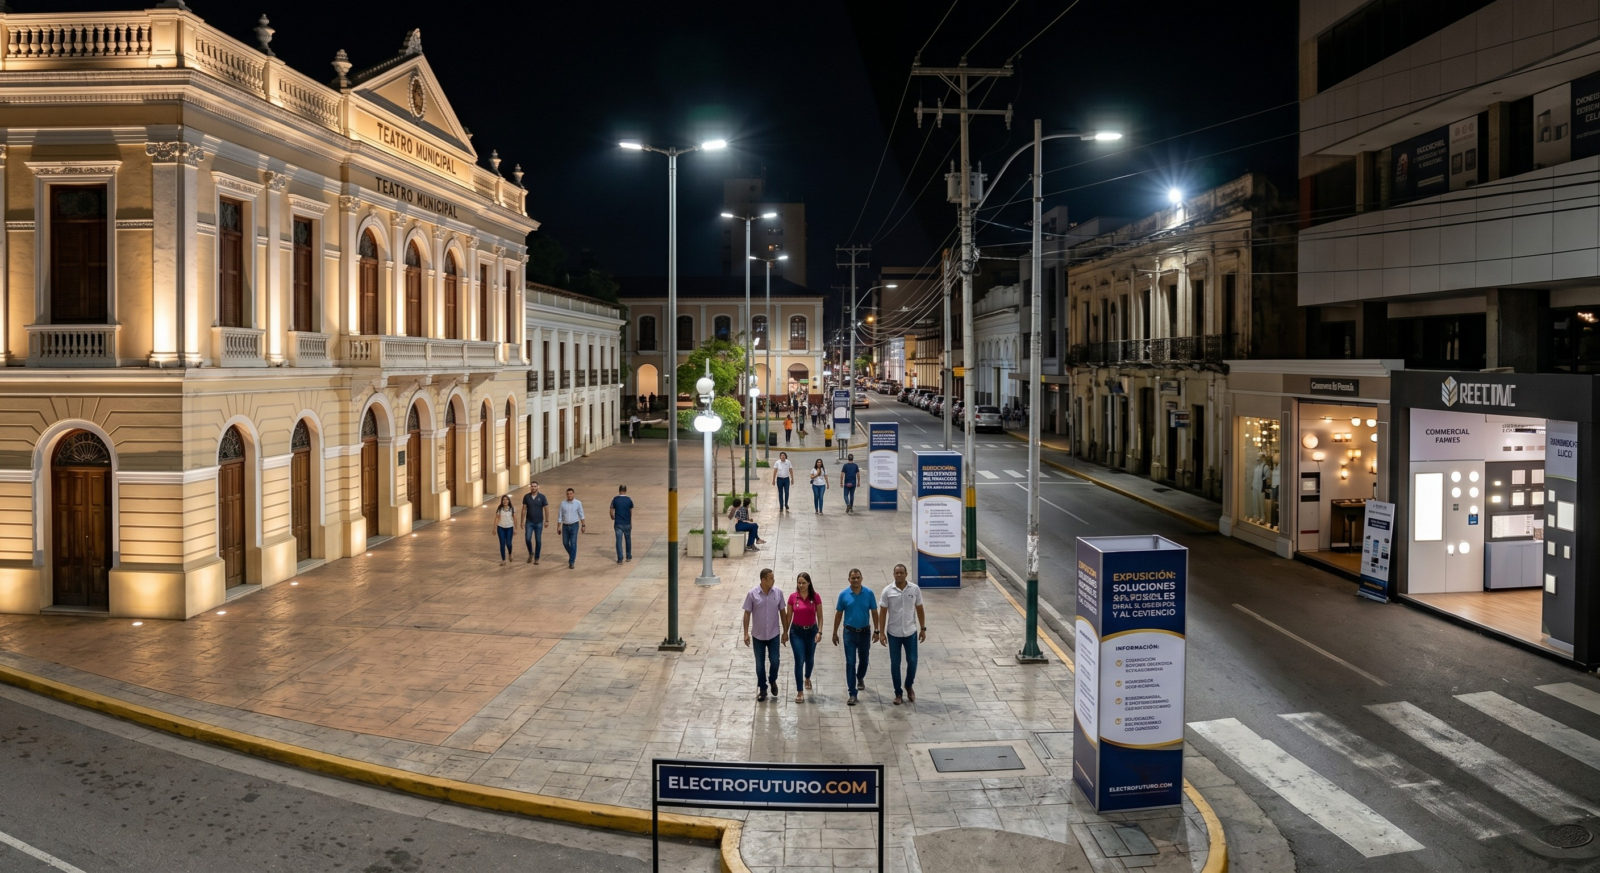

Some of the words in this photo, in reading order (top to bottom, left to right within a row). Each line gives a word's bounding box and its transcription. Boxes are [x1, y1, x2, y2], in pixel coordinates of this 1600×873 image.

[377, 122, 413, 154] TEATRO
[416, 142, 457, 175] MUNICIPAL
[375, 176, 413, 203] TEATRO
[417, 192, 458, 219] MUNICIPAL
[1113, 582, 1176, 592] SOLUCIONES
[668, 775, 867, 795] ELECTROFUTURO.COM
[1109, 783, 1173, 792] ELECTROFUTURO.COM
